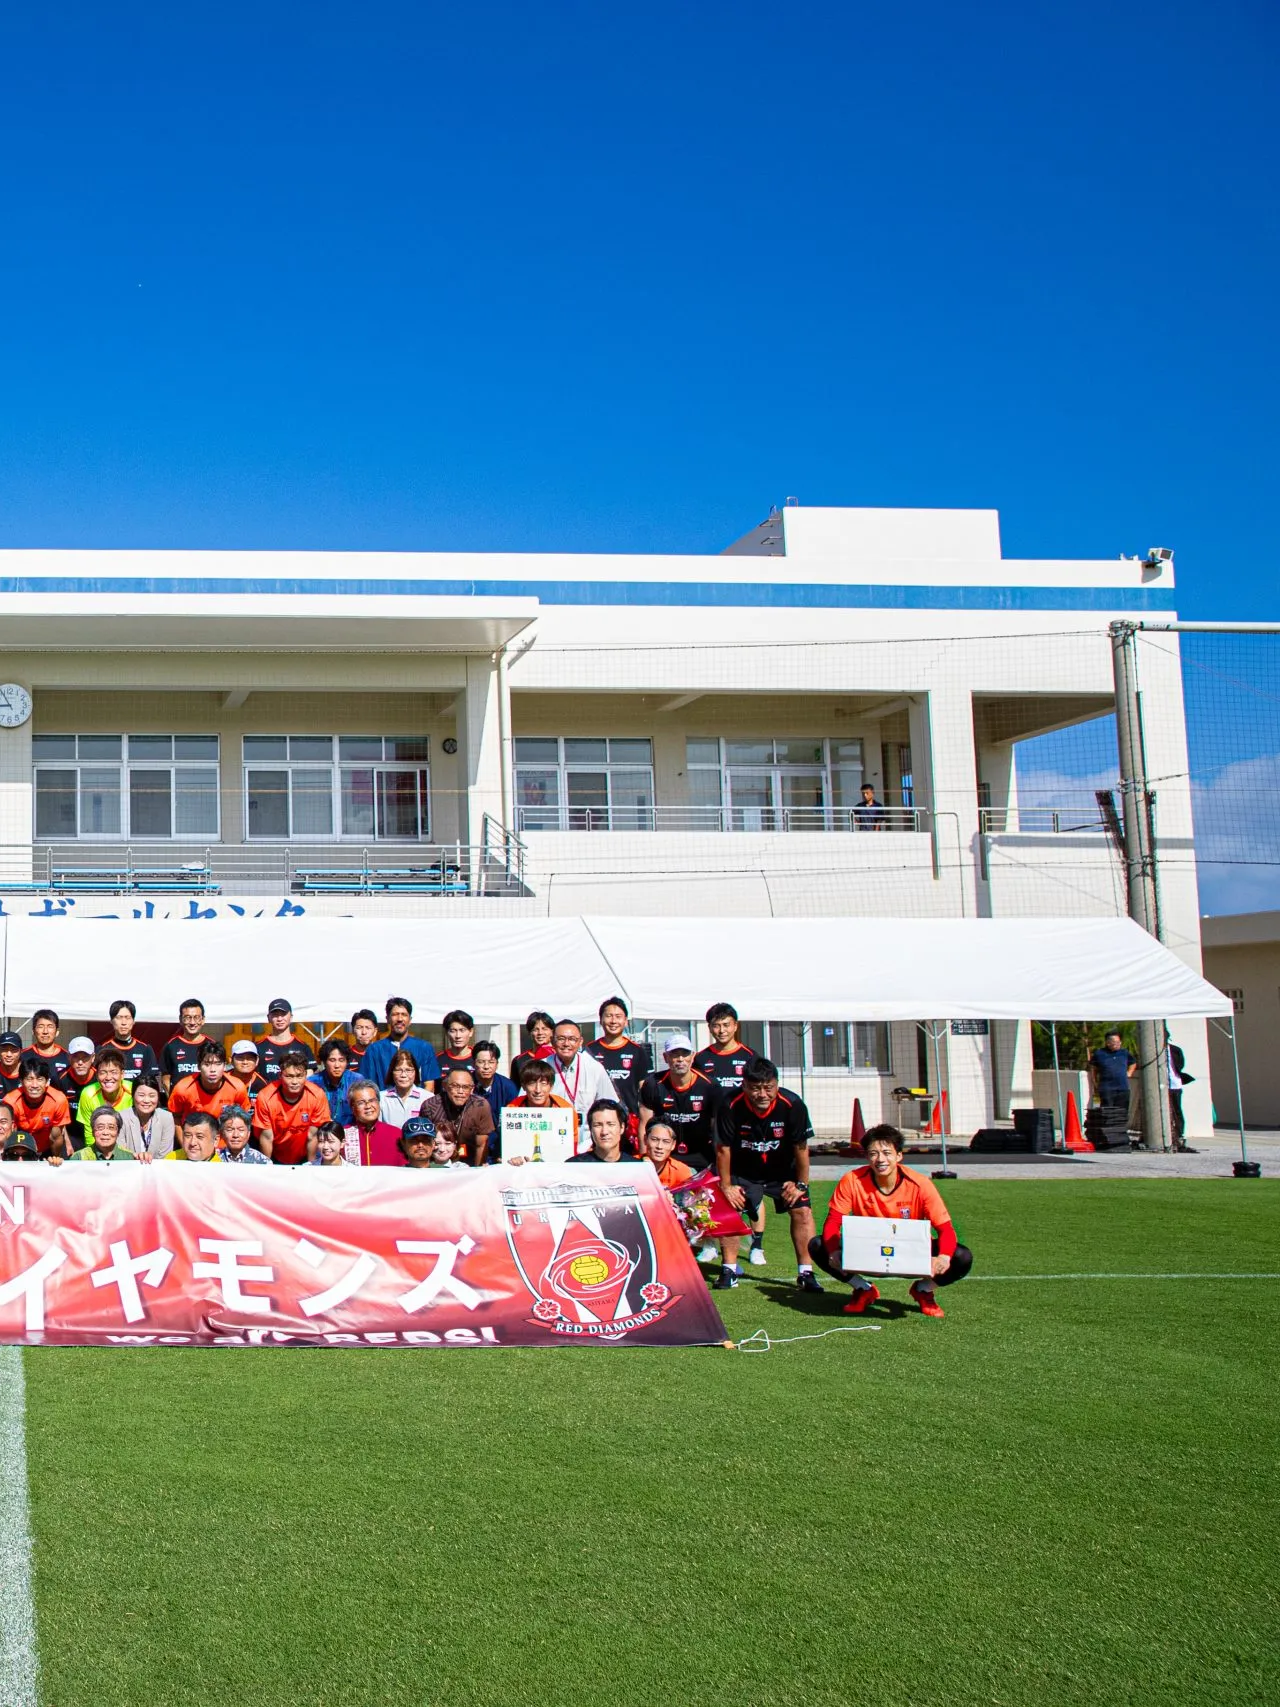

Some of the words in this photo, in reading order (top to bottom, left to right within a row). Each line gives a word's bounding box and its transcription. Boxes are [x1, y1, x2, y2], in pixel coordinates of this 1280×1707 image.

[16, 1134, 26, 1143] P
[512, 1205, 634, 1226] URAWA
[555, 1322, 584, 1335] RED
[588, 1307, 661, 1335] DIAMONDS
